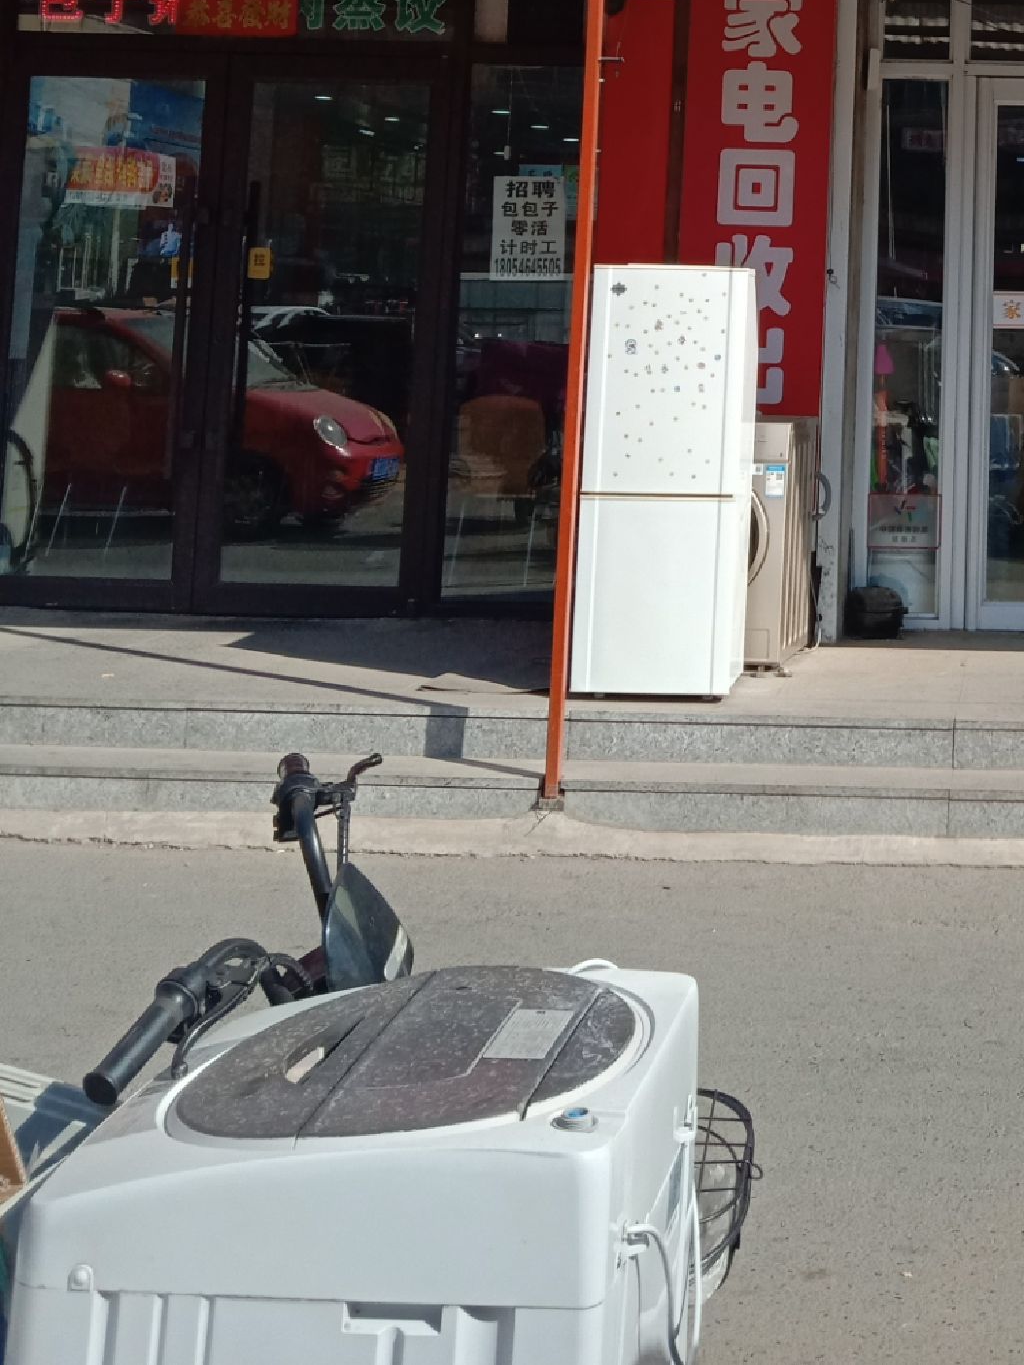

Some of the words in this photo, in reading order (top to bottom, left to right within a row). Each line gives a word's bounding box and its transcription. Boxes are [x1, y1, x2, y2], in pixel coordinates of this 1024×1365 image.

[505, 180, 556, 198] 招聘
[501, 200, 559, 217] 包包子
[511, 220, 548, 236] 零活
[500, 239, 558, 255] 计时工
